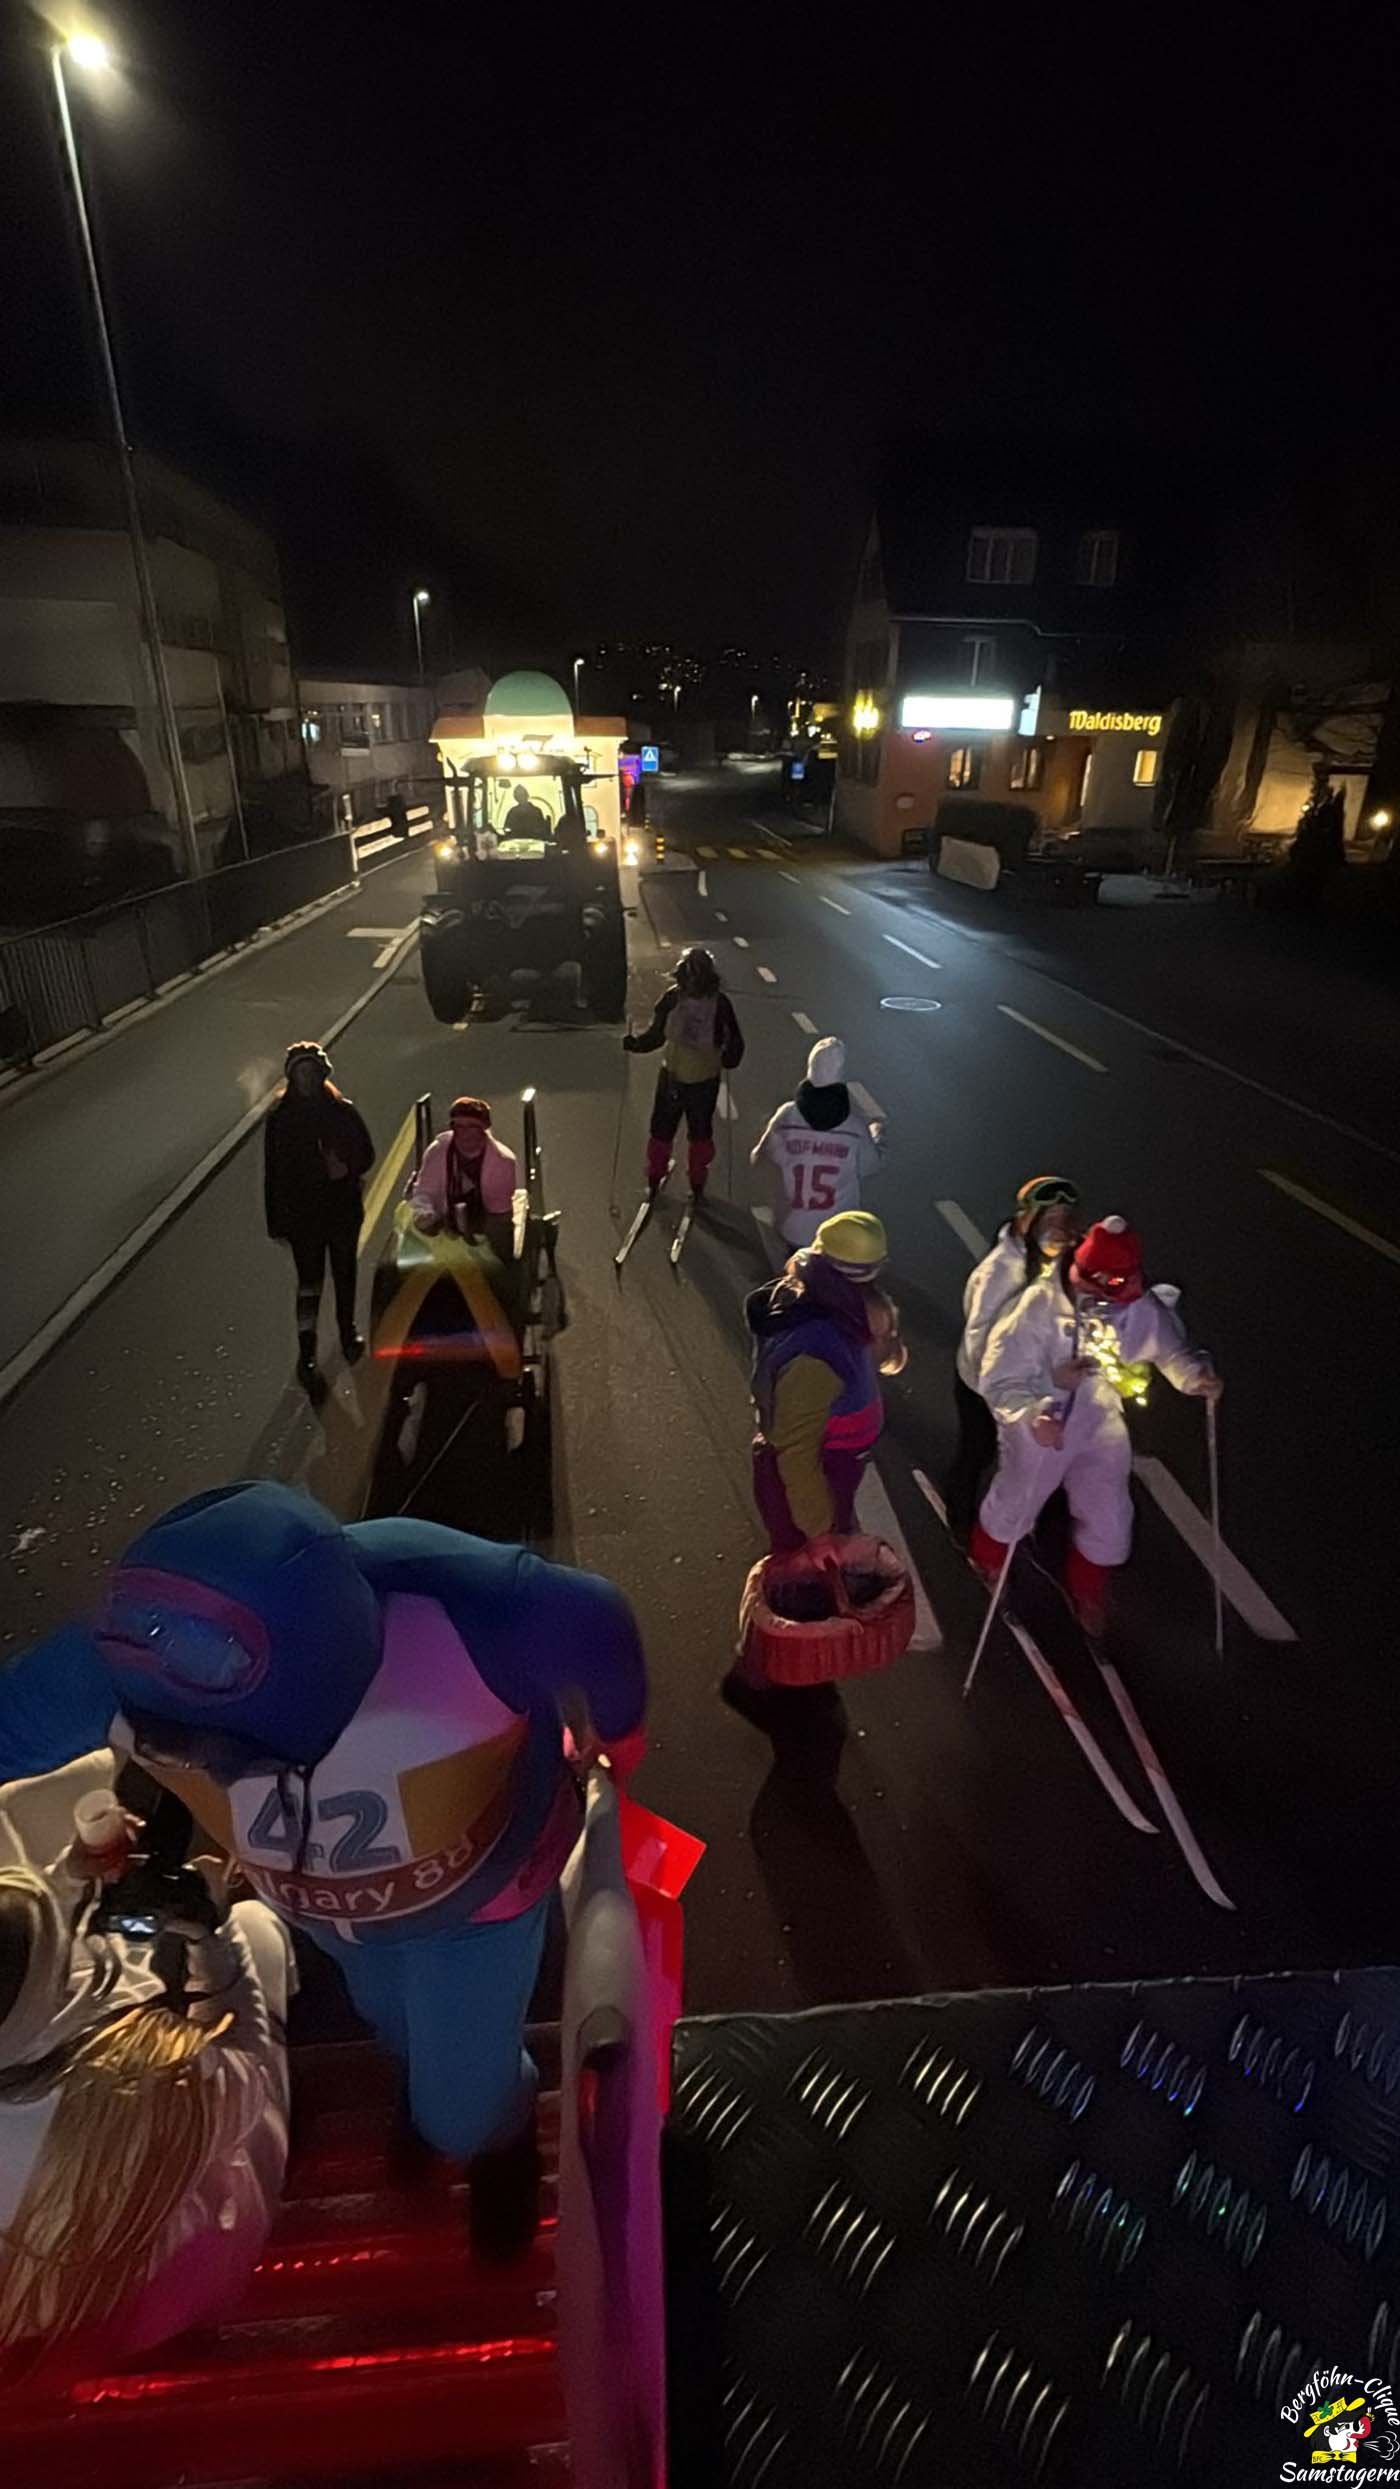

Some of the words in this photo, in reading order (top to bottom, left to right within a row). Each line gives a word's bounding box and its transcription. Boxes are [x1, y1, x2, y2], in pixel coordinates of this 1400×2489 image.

[1069, 710, 1162, 736] Waldisberg
[791, 1164, 840, 1210] 15
[248, 1787, 402, 1873] 42
